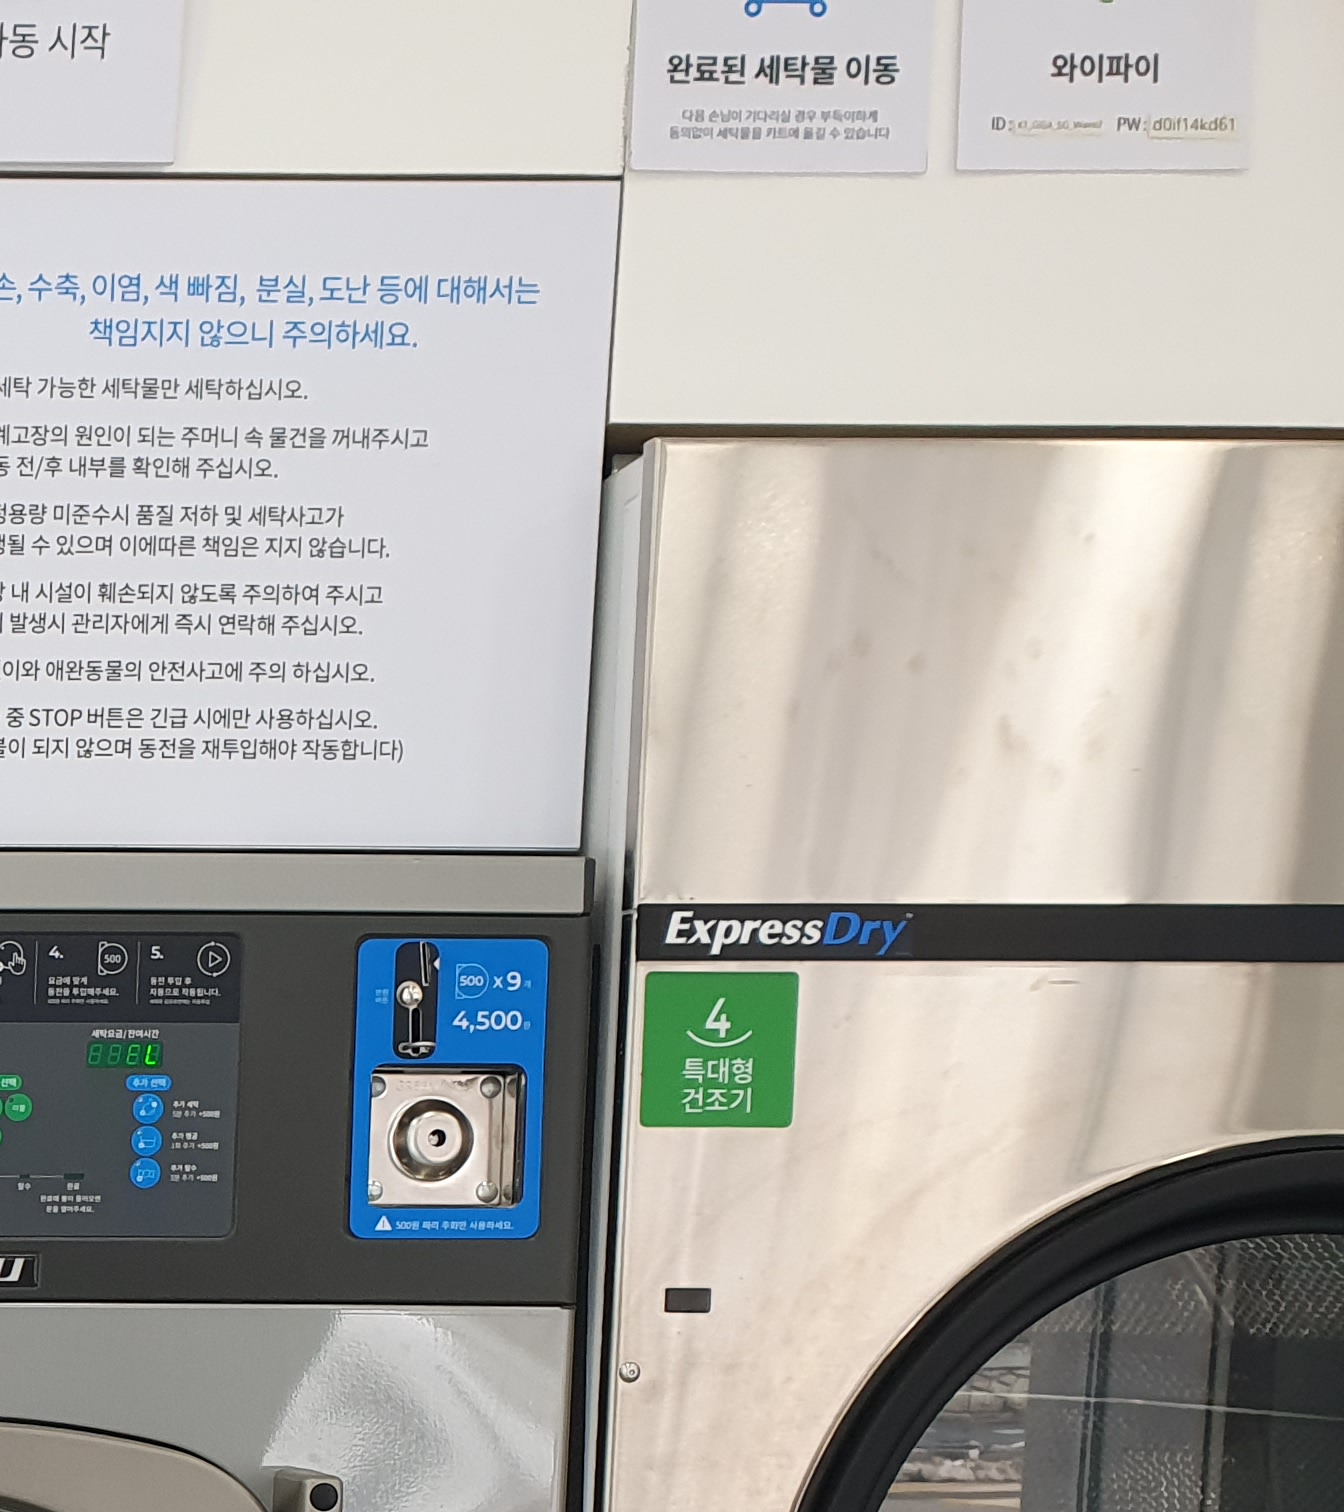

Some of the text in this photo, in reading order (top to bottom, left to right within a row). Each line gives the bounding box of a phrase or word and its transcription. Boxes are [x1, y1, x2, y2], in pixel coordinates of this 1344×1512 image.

[49, 23, 110, 59] 시작
[667, 54, 899, 85] 완료된 세탁물 이동
[1051, 53, 1159, 83] 와이파이
[28, 273, 85, 305] 수축,
[93, 273, 148, 305] 이염,
[155, 274, 178, 302] 색
[187, 274, 245, 306] 빠짐,
[257, 275, 313, 306] 분실,
[320, 275, 371, 303] 도난
[377, 275, 428, 304] 등에
[437, 276, 540, 304] 대해서는
[90, 318, 417, 349] 책임지지 않으니 주의하세요.
[38, 377, 96, 398] 가능한
[102, 378, 180, 399] 세탁물만
[185, 378, 307, 400] 세탁하십시오.
[10, 612, 64, 634] 발생시
[72, 613, 168, 634] 관리자에게
[175, 614, 211, 635] 즉시
[219, 614, 275, 636] 연락해
[281, 615, 362, 636] 주십시오.
[665, 910, 906, 955] ExpressDry
[459, 975, 484, 986] 500
[705, 998, 731, 1038] 4
[682, 1058, 753, 1083] 특대형
[682, 1088, 751, 1113] 건조기
